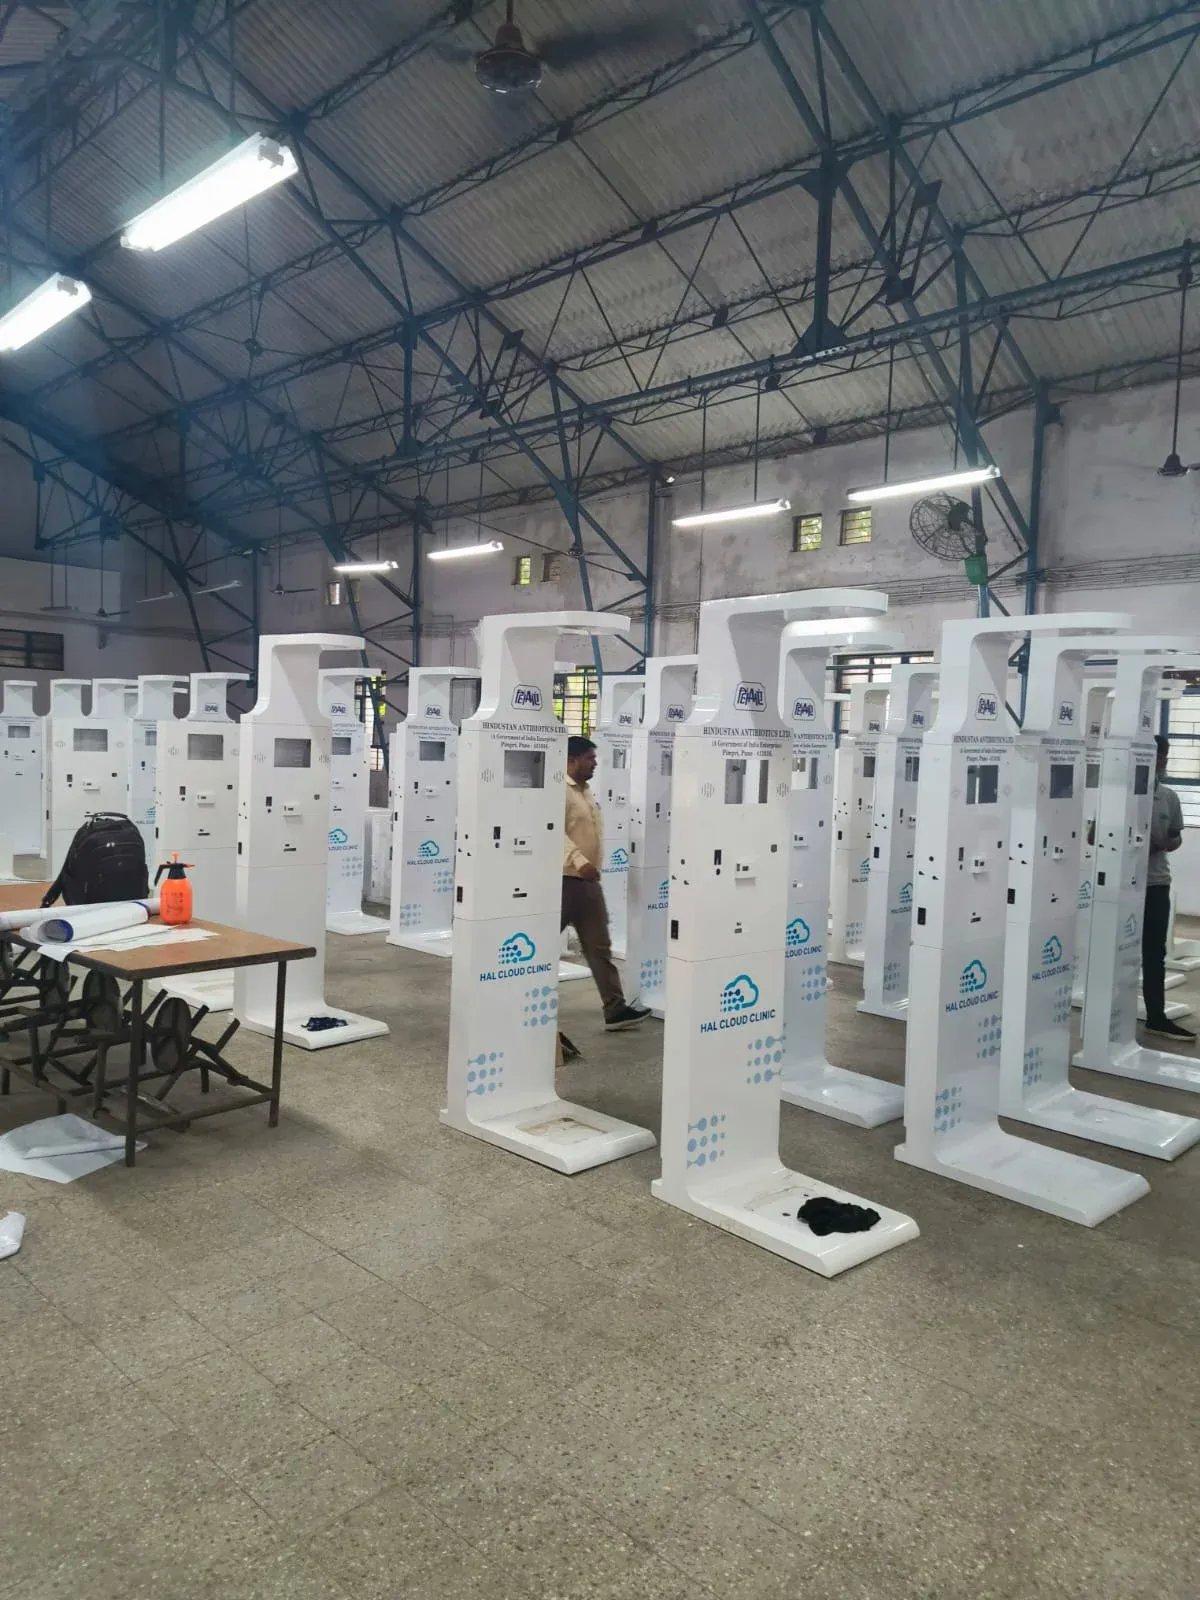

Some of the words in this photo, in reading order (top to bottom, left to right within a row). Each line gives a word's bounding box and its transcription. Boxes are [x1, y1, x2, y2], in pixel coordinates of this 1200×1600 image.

[482, 722, 517, 731] HINDUSTAN
[519, 724, 554, 733] ANTIBIOTICS
[703, 727, 740, 736] HINDUSTAN
[740, 728, 778, 737] ANTIBIOTICS
[803, 944, 822, 955] CLINIC
[479, 972, 497, 982] HAL
[497, 967, 525, 979] CLOUD
[526, 963, 552, 975] CLINIC
[945, 1001, 958, 1013] HAL
[958, 995, 979, 1009] CLOUD
[980, 990, 1000, 1004] CLINIC
[700, 1020, 718, 1033] HAL
[719, 1014, 748, 1030] CLOUD
[749, 1008, 776, 1023] CLINIC
